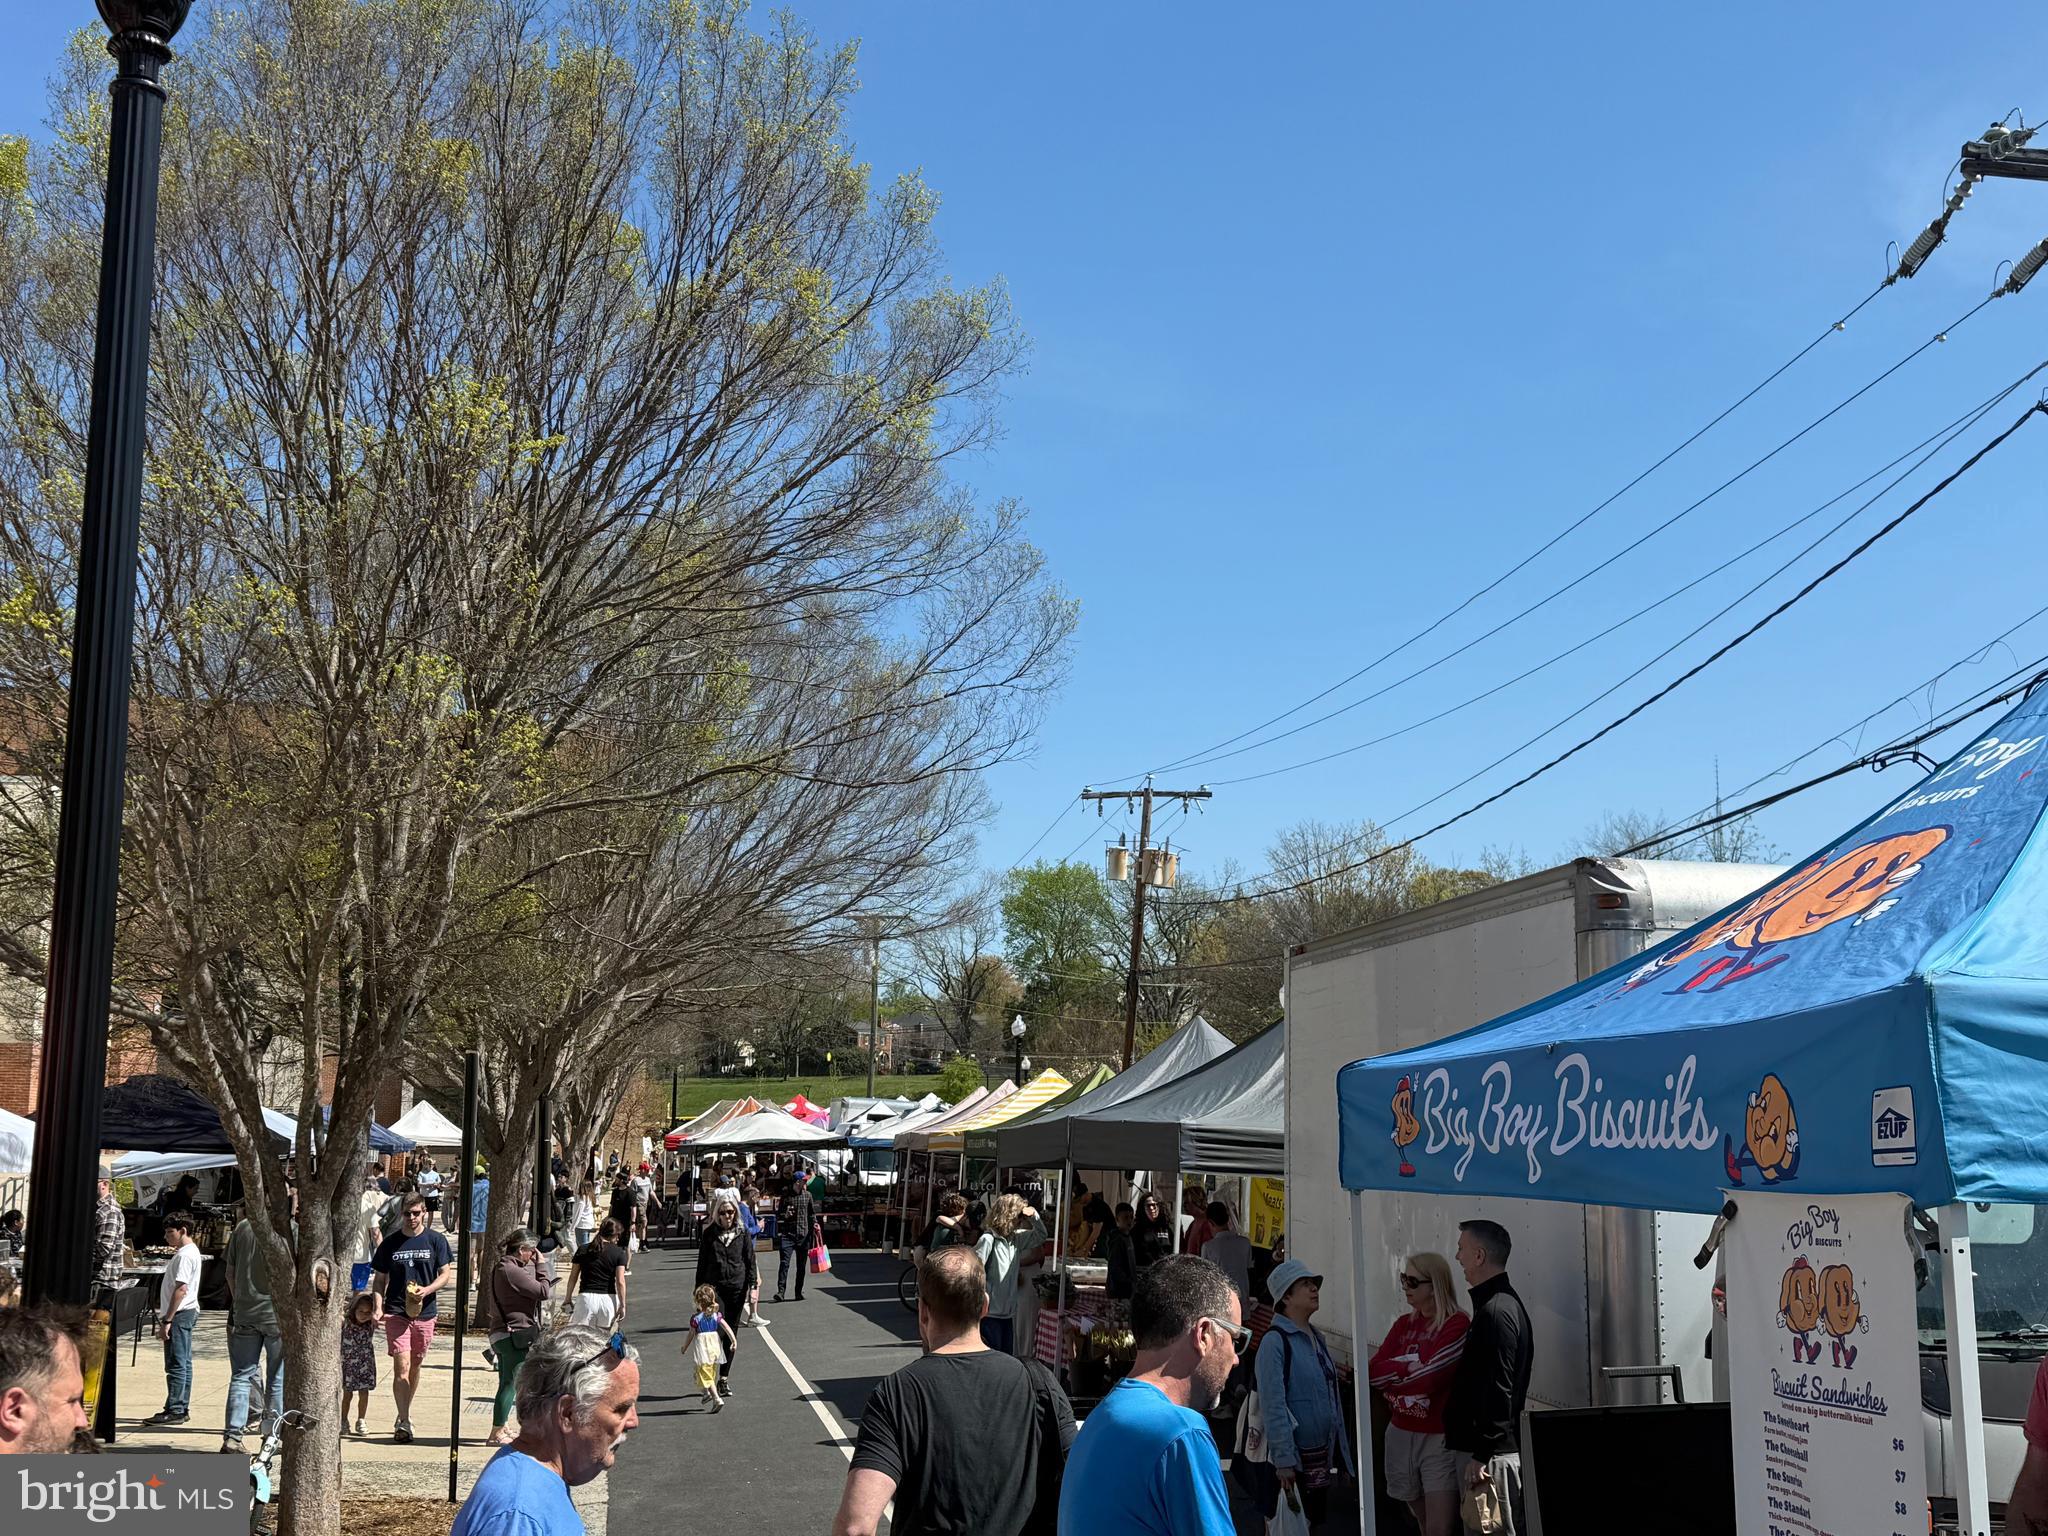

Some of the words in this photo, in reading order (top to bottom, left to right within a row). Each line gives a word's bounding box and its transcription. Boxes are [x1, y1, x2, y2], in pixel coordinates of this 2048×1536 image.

[1423, 1068, 1475, 1182] Big
[1479, 1061, 1548, 1184] Boy
[1550, 1053, 1718, 1156] Biscuits
[1787, 1219, 1813, 1250] Big
[1807, 1205, 1840, 1234] Boy
[1815, 1238, 1842, 1248] BISCUITS
[1771, 1368, 1809, 1399] Biscuit
[1811, 1376, 1888, 1413] Sandwiches
[1763, 1411, 1777, 1424] The
[1807, 1406, 1818, 1418] big
[1819, 1408, 1853, 1422] buttermilk
[1853, 1413, 1873, 1426] biscuit
[1765, 1439, 1779, 1453] The
[1892, 1437, 1905, 1452] $6
[1766, 1467, 1781, 1481] The
[1895, 1468, 1906, 1484] $7
[1767, 1496, 1783, 1511] The
[1895, 1500, 1907, 1516] $8
